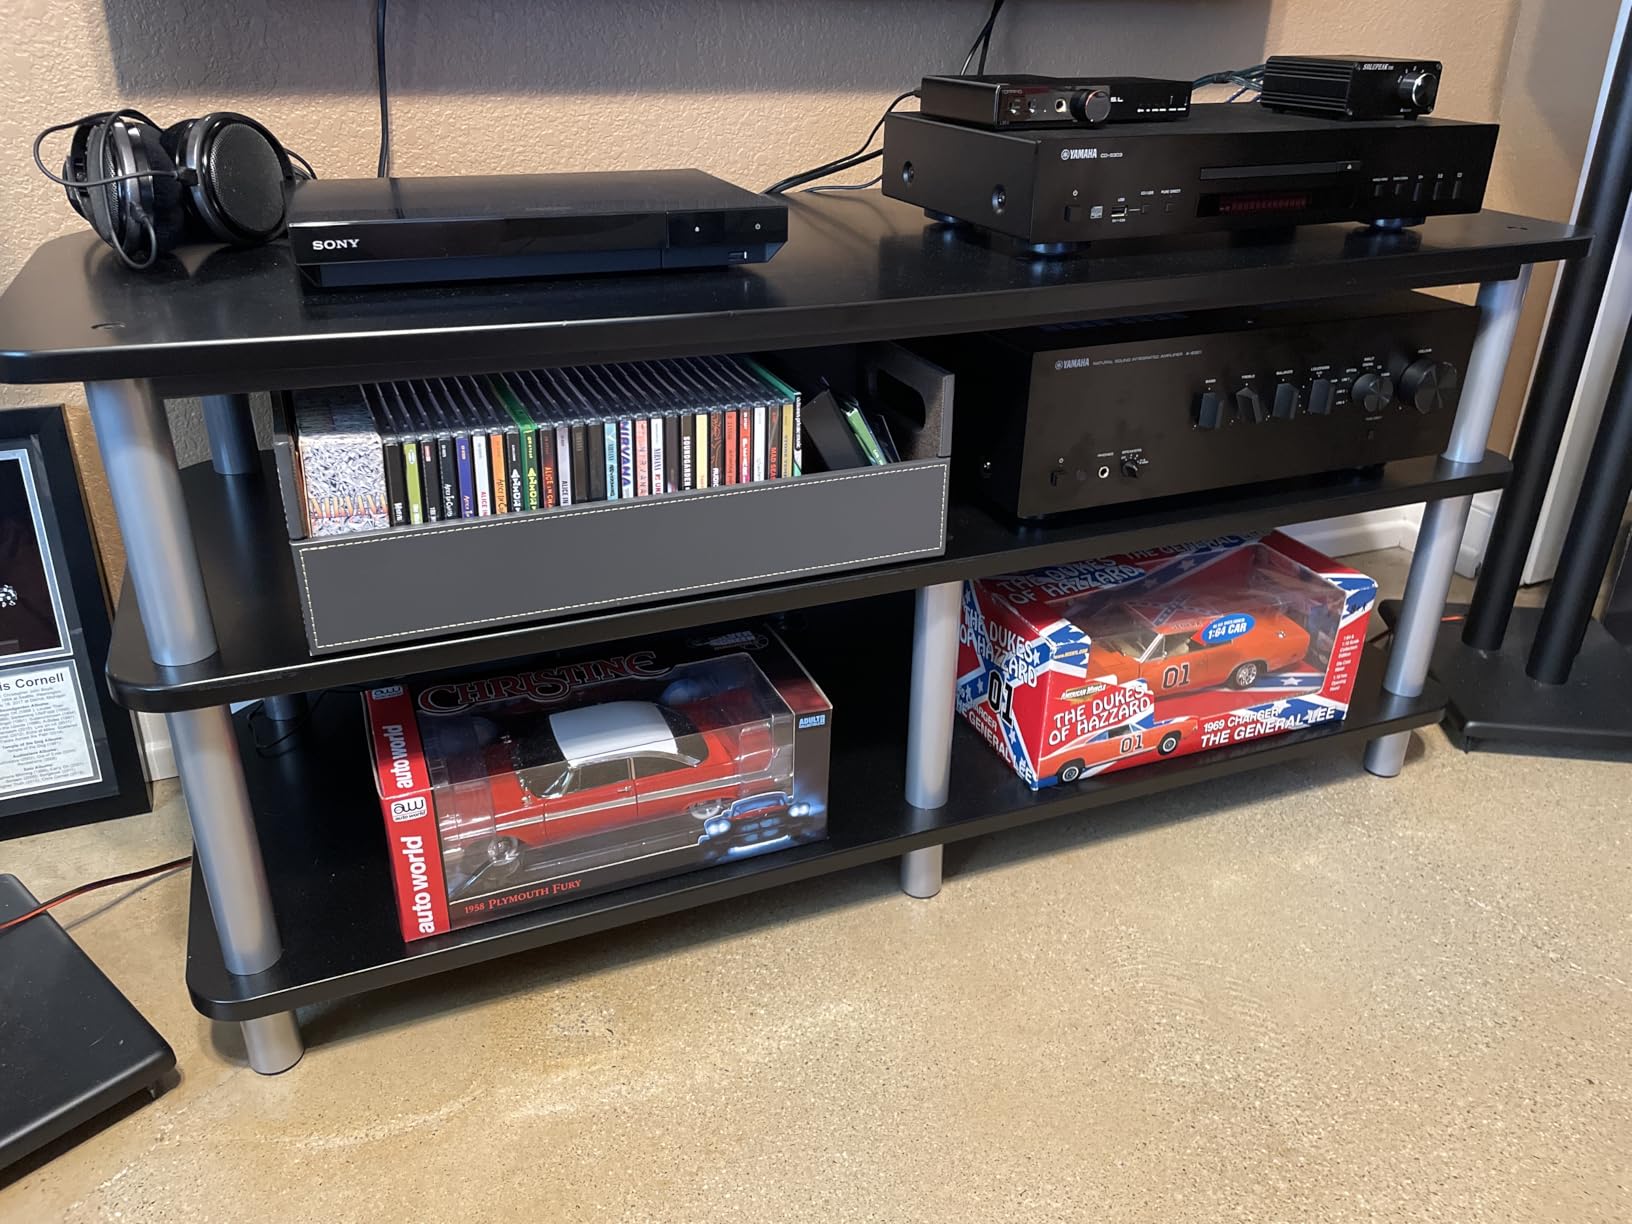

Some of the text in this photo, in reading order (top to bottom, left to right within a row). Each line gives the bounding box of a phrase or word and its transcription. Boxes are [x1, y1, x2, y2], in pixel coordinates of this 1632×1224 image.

[1070, 148, 1097, 159] YAMAHA
[312, 239, 360, 250] SONY
[1063, 357, 1090, 369] YAMAHA
[620, 420, 631, 487] NIRVANA
[639, 446, 647, 494] NIRVANA
[683, 436, 691, 486] SOUNDGARDEN
[544, 466, 554, 484] ALICE
[561, 480, 569, 505] ALICE IN
[309, 491, 389, 520] NIRVANA
[997, 559, 1117, 592] THE DUKES
[1008, 564, 1138, 605] OF HAZZARD
[963, 605, 1034, 663] THE DUKES
[1208, 624, 1228, 640] 1:64
[1228, 622, 1247, 634] CAR
[959, 623, 1038, 688] OF HAZZARD
[15, 672, 65, 689] Cornell
[418, 650, 672, 717] CHRISTINE
[1162, 662, 1190, 689] 01
[987, 669, 1015, 729] 01
[1053, 686, 1144, 729] THE DUKES
[1048, 697, 1151, 745] OF HAZZARD
[1201, 707, 1335, 748] THE GENERAL LEE
[1203, 707, 1279, 732] 1969 CHARGER
[382, 724, 414, 789] auto world
[969, 711, 1011, 765] GENERAL
[1013, 754, 1033, 785] LEE
[1120, 732, 1143, 754] 01
[408, 810, 426, 819] world
[400, 835, 435, 934] auto world
[464, 879, 582, 914] 1958 PLYMOUTH FURY
